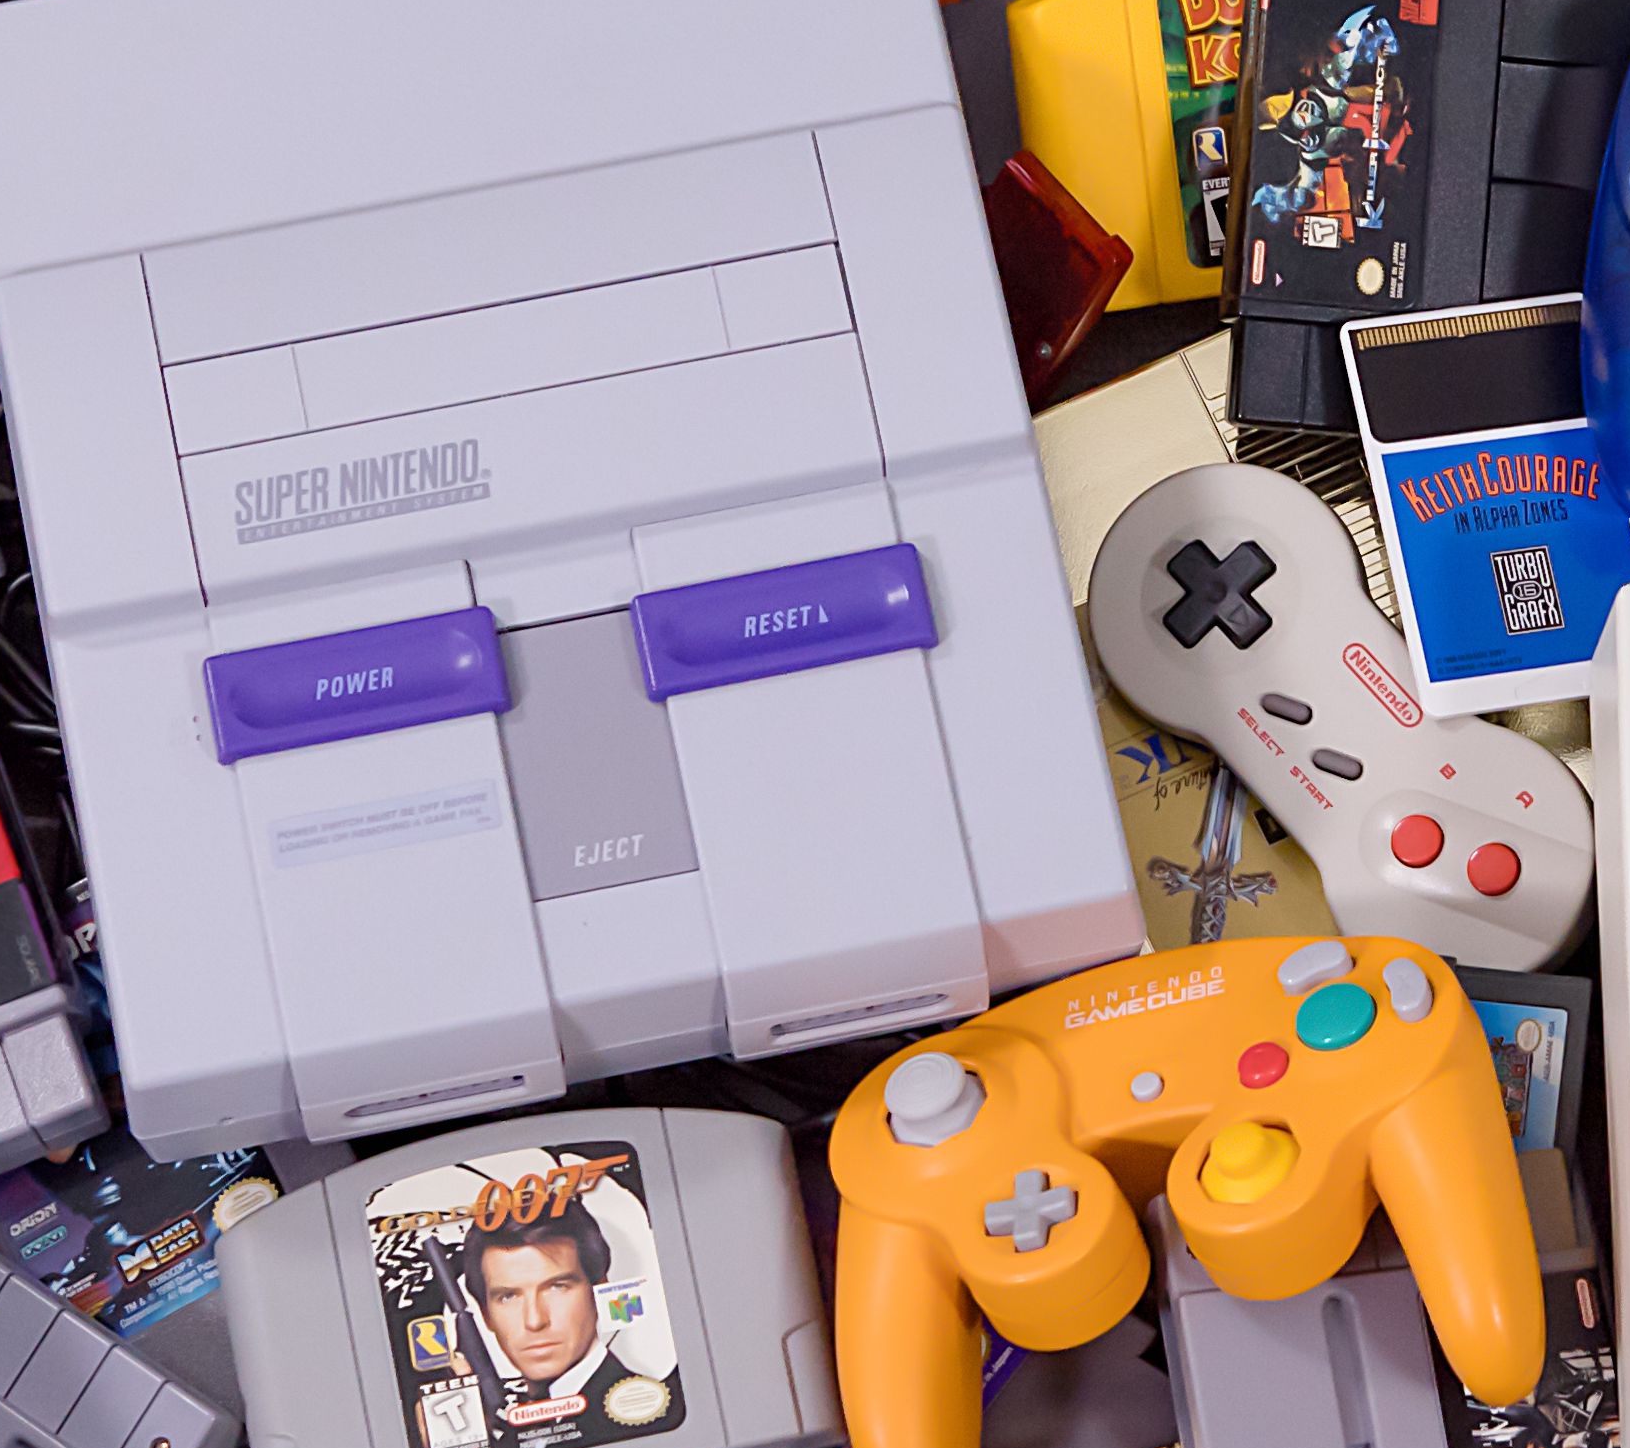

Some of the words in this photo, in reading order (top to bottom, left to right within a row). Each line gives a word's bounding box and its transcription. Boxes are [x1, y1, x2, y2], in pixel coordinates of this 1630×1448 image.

[1372, 47, 1390, 147] INSTINCT
[234, 469, 328, 524] SUPER
[344, 439, 478, 506] NINTENDO
[1400, 462, 1478, 522] KEITH
[1477, 451, 1600, 500] COURAGE
[240, 503, 406, 543] ENTERTAINMENT
[411, 485, 488, 512] SYSTEM
[743, 606, 811, 639] RESET
[316, 667, 394, 700] POWER
[1348, 647, 1414, 723] Nintendo
[574, 834, 644, 868] EJECT
[1065, 978, 1225, 1029] GAMECUBE
[1067, 966, 1225, 1011] NINTENDO
[475, 1154, 629, 1234] 007
[155, 1220, 195, 1245] DATA
[156, 1231, 199, 1260] EAST
[420, 1375, 477, 1395] TEEN
[513, 1398, 583, 1423] Nintendo
